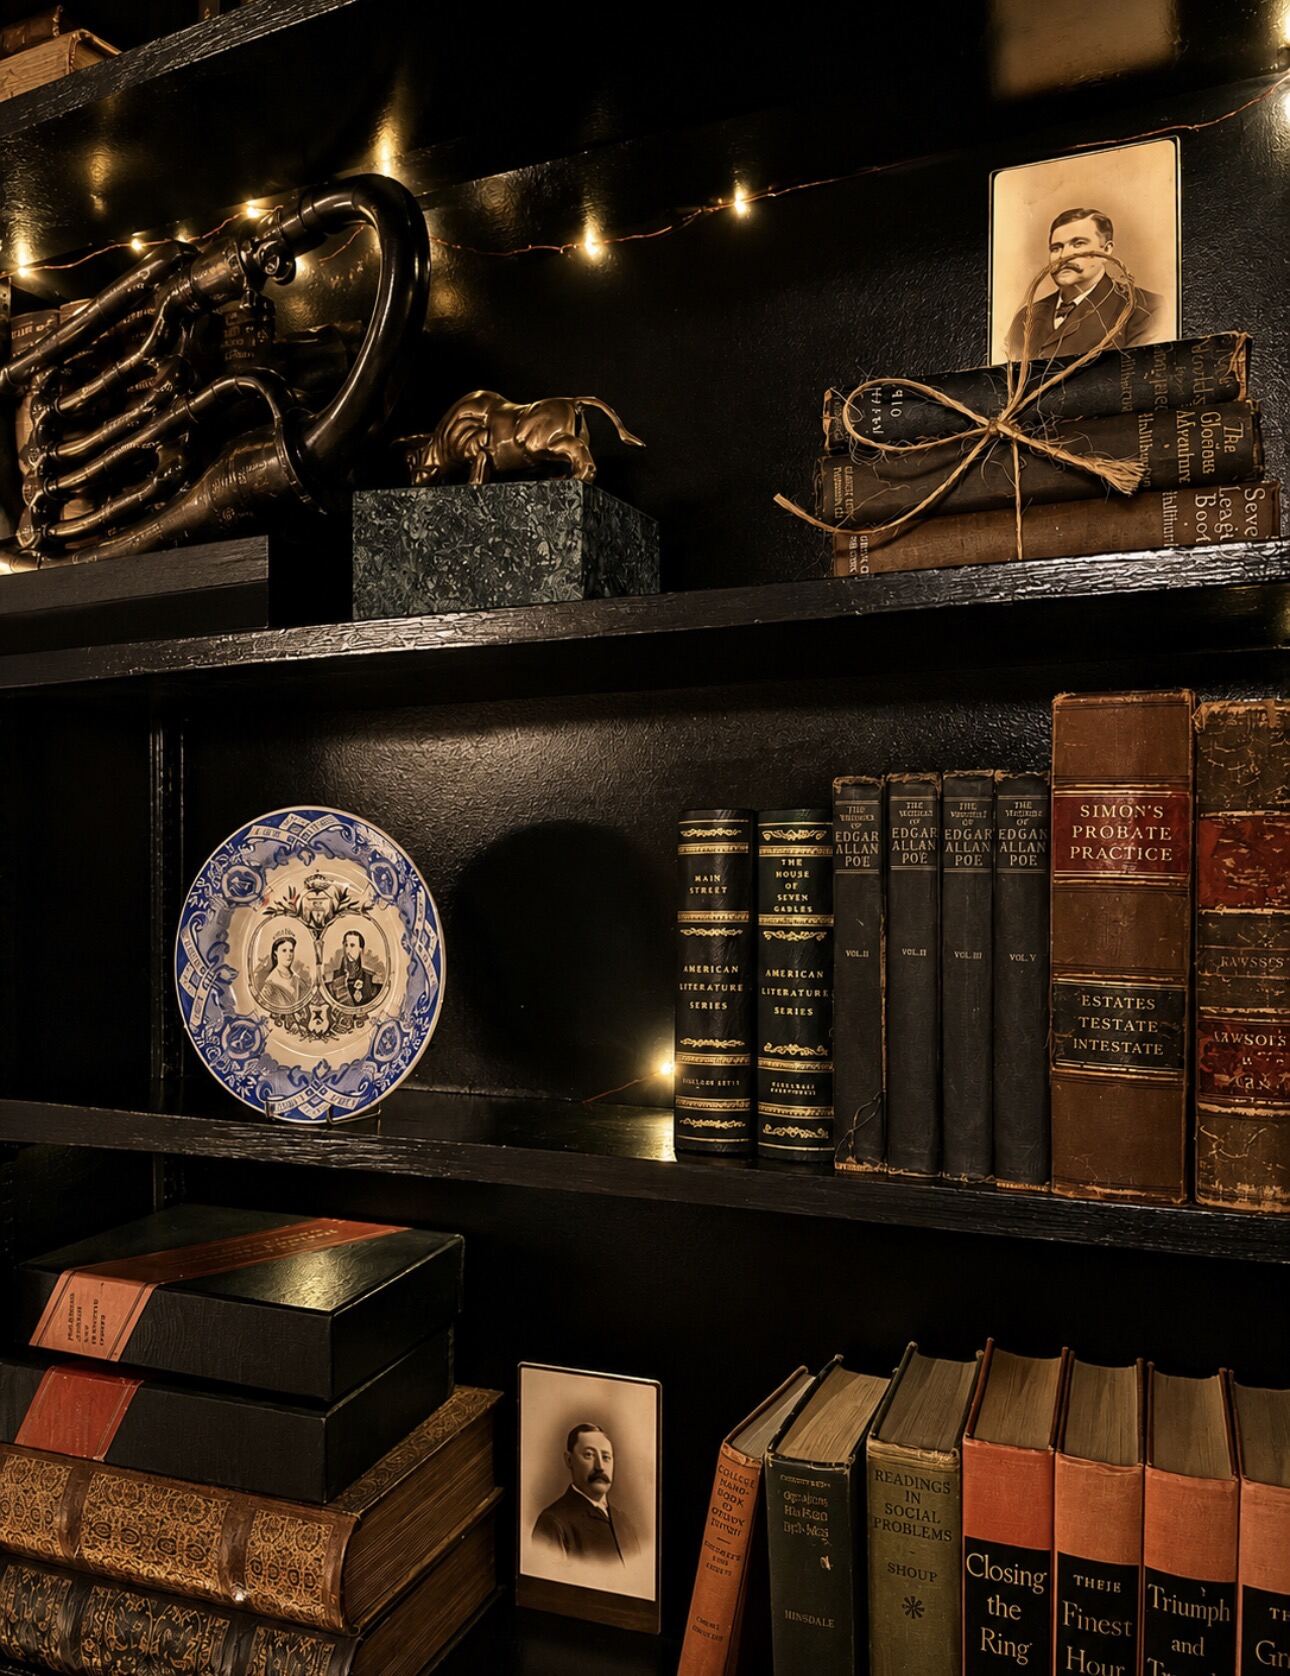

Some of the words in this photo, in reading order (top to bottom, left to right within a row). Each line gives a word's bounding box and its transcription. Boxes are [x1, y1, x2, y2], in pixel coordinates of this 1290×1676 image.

[1223, 423, 1244, 453] The
[1080, 804, 1164, 819] SIMON'S
[835, 831, 879, 842] EDGAR
[892, 827, 937, 838] EDGAR
[944, 828, 992, 840] EDGAR
[1072, 825, 1172, 840] PROBATE
[835, 843, 879, 854] ALLAN
[891, 840, 936, 851] ALLAN
[945, 842, 990, 853] ALLAN
[999, 842, 1046, 853] ALLAN
[902, 852, 928, 864] POE
[1070, 846, 1173, 861] PRACTICE
[781, 858, 803, 867] THE
[845, 856, 871, 867] POE
[955, 854, 983, 866] POE
[1010, 854, 1038, 866] POE
[694, 874, 721, 882] MAIN
[775, 870, 810, 879] HOUSE
[689, 886, 728, 895] STREET
[784, 882, 799, 890] OF
[776, 893, 809, 902] SEVEN
[1030, 954, 1037, 962] V
[683, 965, 739, 974] AMERICAN
[765, 969, 824, 979] AMERICAN
[679, 983, 744, 992] LITERATURE
[761, 987, 829, 998] LITERATURE
[689, 1001, 728, 1010] SERIES
[1081, 995, 1156, 1010] ESTATES
[773, 1006, 814, 1016] SERIES
[1078, 1016, 1159, 1033] TESTATE
[1073, 1038, 1164, 1055] INTESTATE
[874, 1469, 952, 1495] READINGS
[904, 1490, 921, 1505] IN
[884, 1503, 942, 1524] SOCIAL
[873, 1516, 953, 1543] PROBLEMS
[887, 1562, 938, 1583] SHOUP
[966, 1552, 1048, 1595] Closing
[987, 1594, 1022, 1621] the
[1147, 1583, 1231, 1627] Triumph
[784, 1609, 836, 1629] HINSDALE
[1062, 1600, 1133, 1637] Finest
[980, 1626, 1033, 1666] Ring
[1171, 1636, 1205, 1657] and
[1065, 1645, 1126, 1676] Hour
